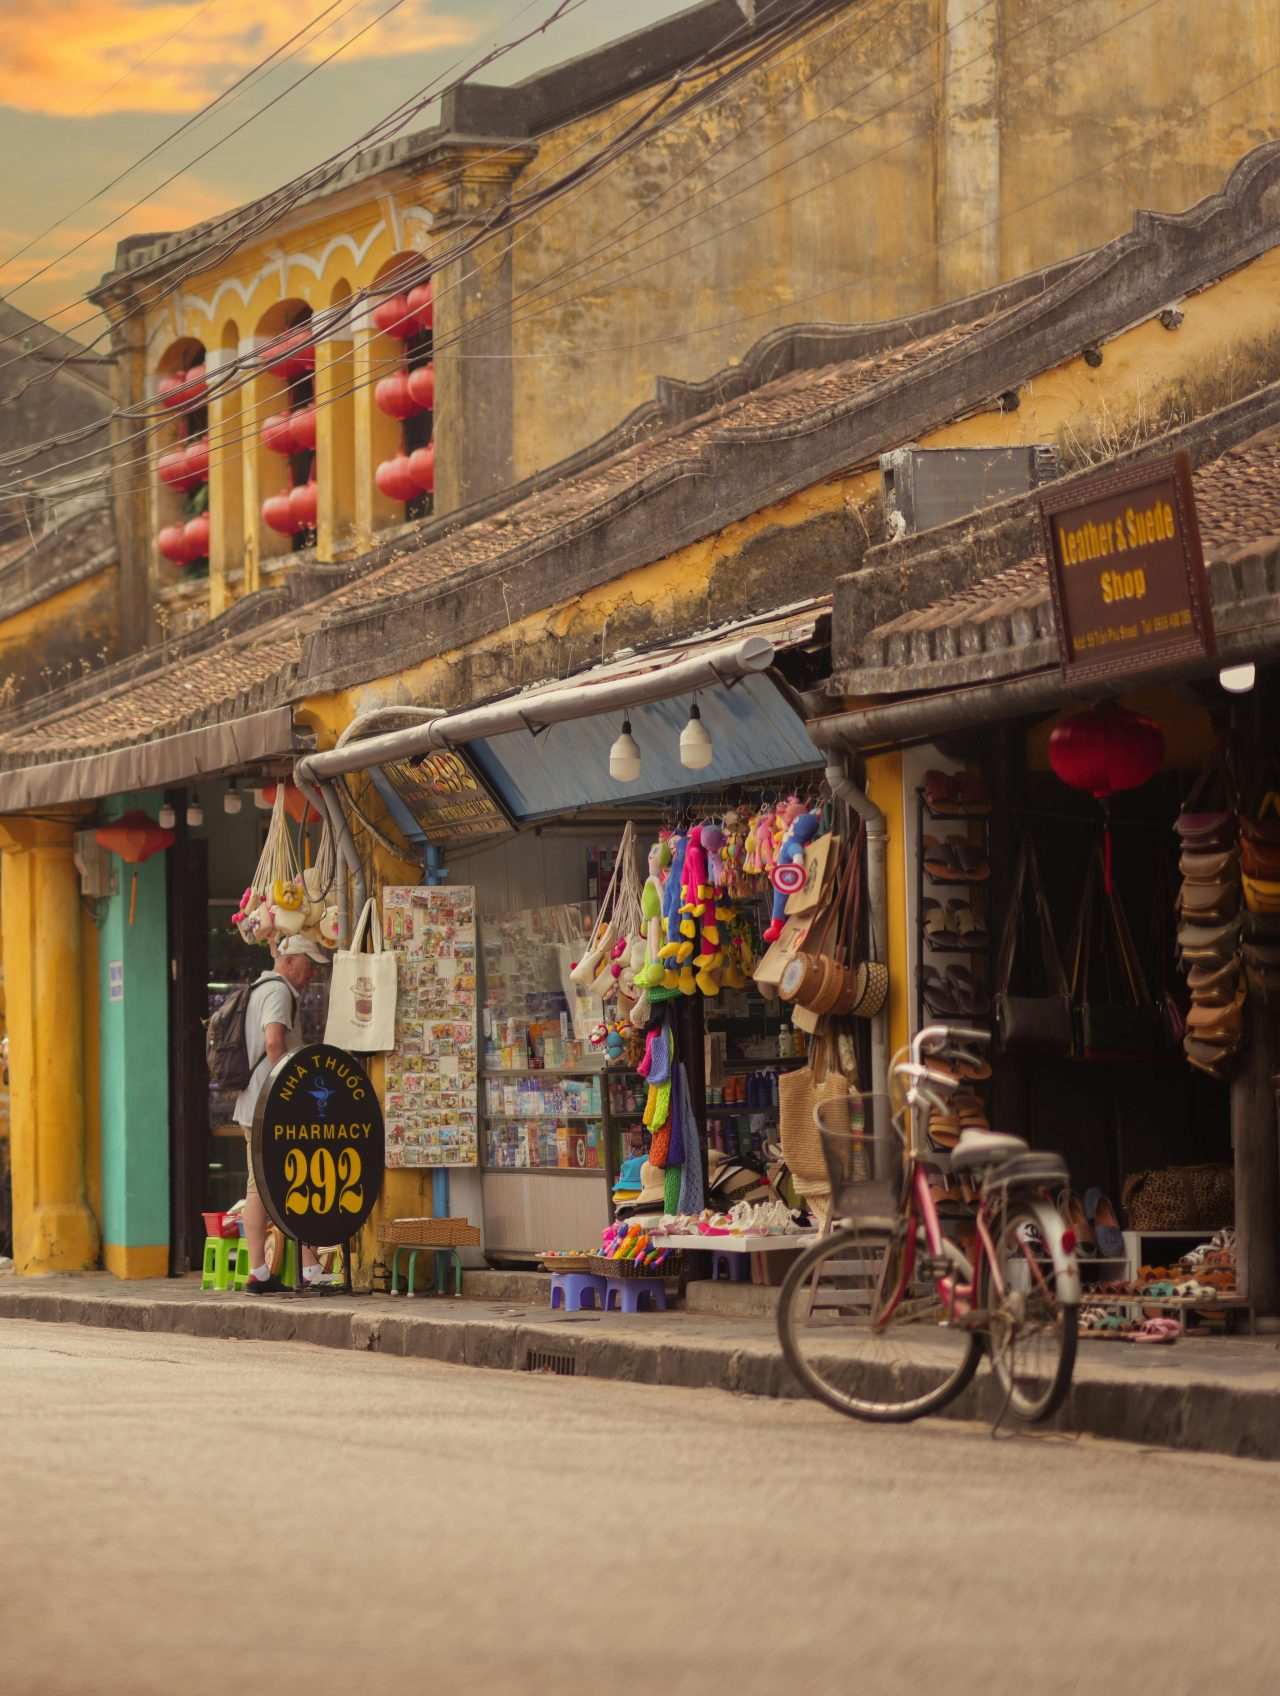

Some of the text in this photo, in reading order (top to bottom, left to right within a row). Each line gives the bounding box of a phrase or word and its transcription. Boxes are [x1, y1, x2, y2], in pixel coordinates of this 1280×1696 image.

[1060, 500, 1175, 567] Leather & Suede
[1101, 568, 1146, 604] Shop
[419, 752, 478, 794] 292
[280, 1055, 365, 1101] NHÀ THUỐC
[274, 1123, 372, 1140] PHARMACY
[284, 1147, 364, 1216] 292
